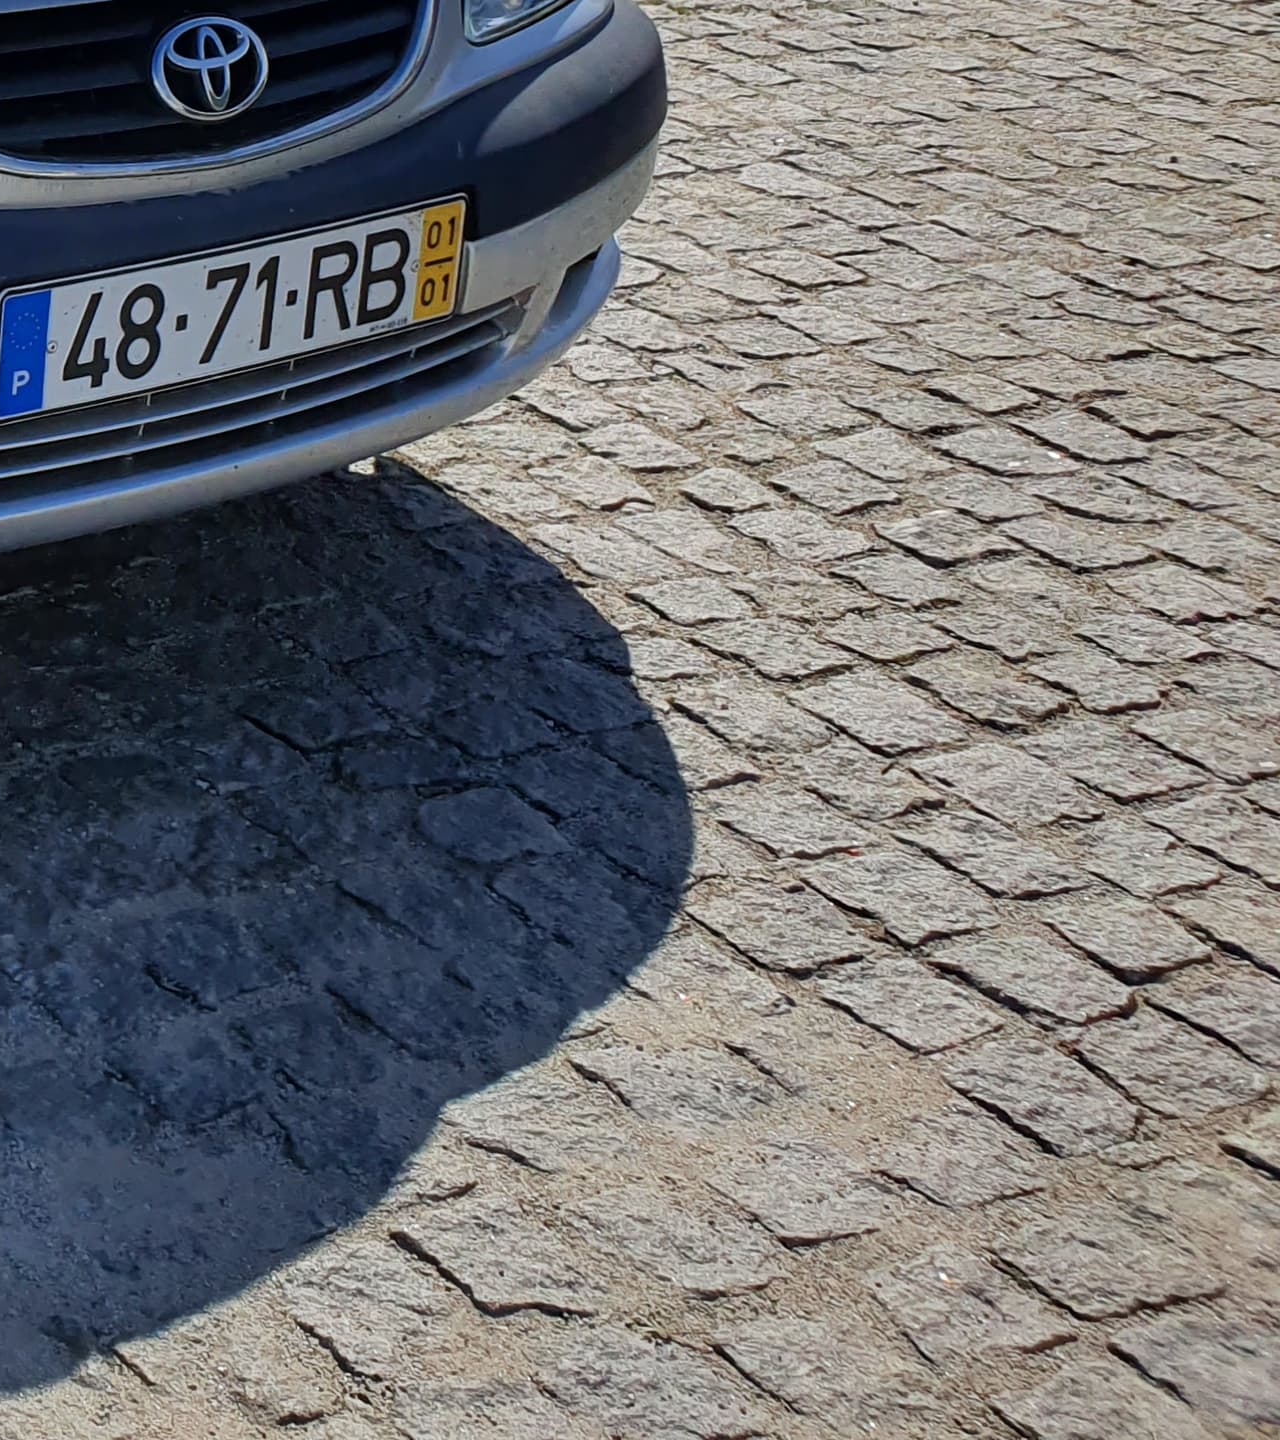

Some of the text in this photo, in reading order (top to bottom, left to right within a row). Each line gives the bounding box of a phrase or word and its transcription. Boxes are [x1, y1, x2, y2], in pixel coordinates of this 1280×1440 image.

[425, 216, 456, 250] 01
[419, 273, 450, 308] 01
[11, 369, 31, 396] P
